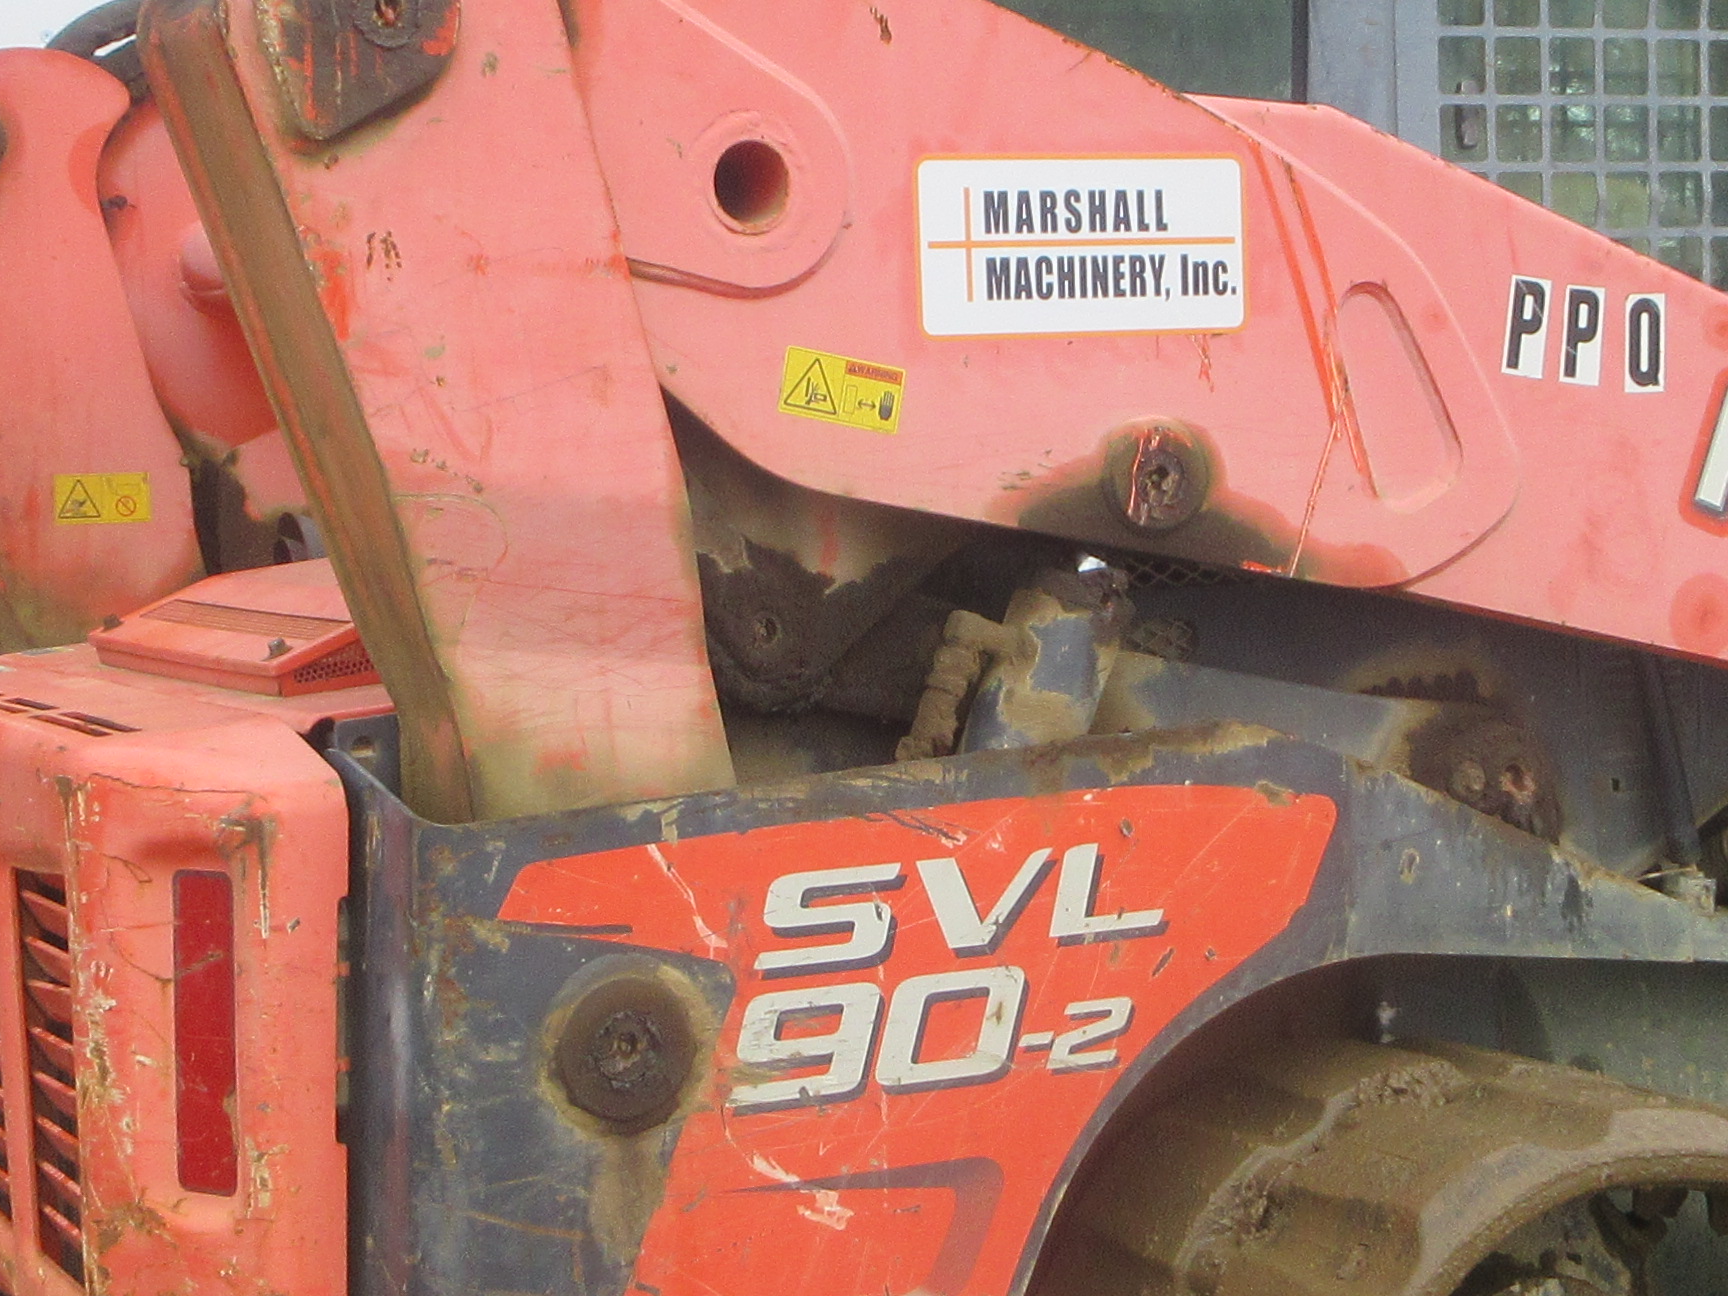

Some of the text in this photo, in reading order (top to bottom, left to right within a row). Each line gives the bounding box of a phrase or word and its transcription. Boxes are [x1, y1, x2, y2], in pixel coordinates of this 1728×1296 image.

[983, 188, 1168, 235] MARSHALL
[985, 254, 1237, 302] MACHINERY, Inc.
[753, 842, 1168, 976] SVL
[727, 965, 1135, 1111] 90-2
